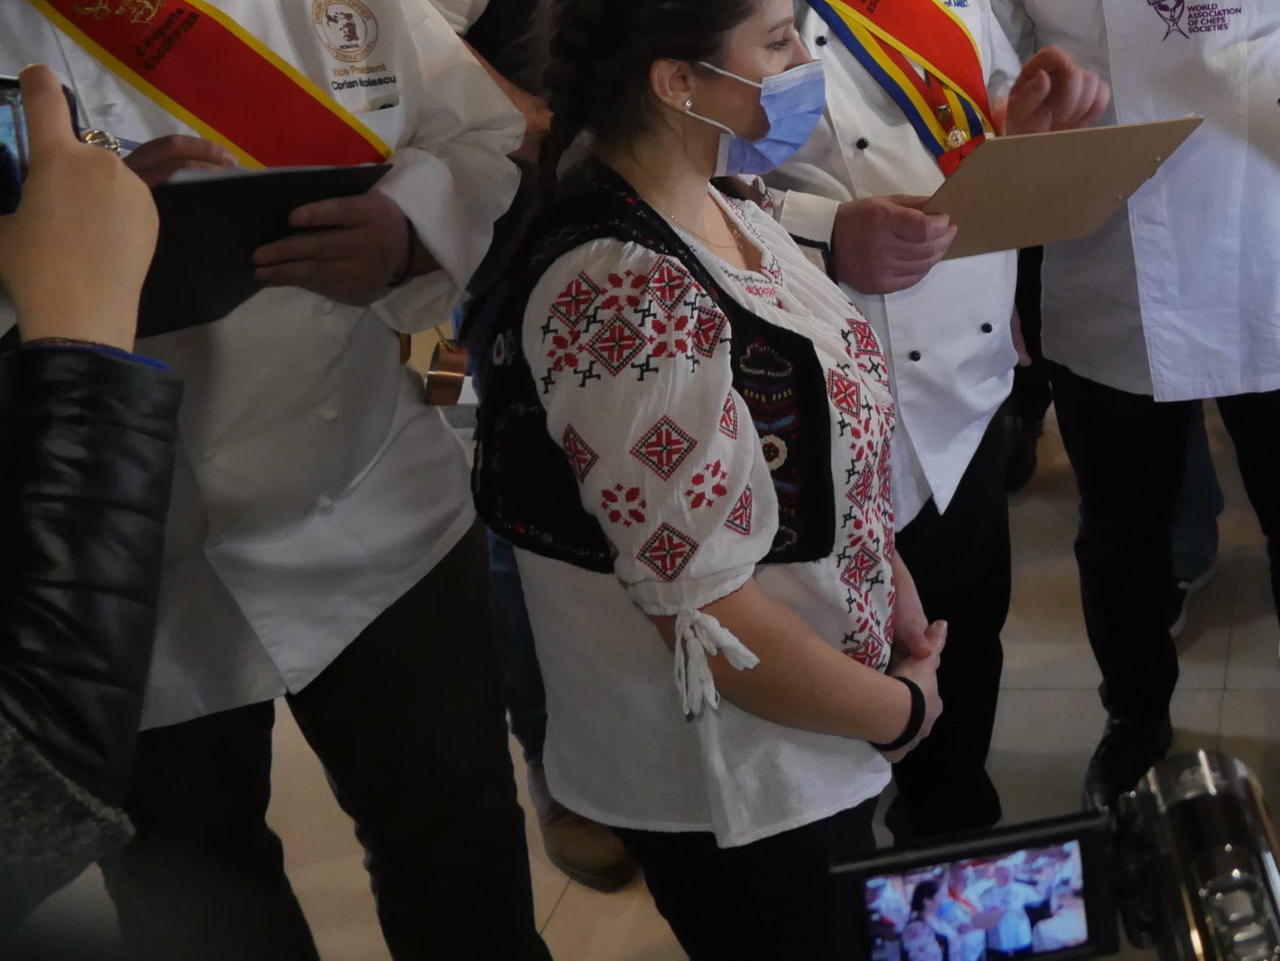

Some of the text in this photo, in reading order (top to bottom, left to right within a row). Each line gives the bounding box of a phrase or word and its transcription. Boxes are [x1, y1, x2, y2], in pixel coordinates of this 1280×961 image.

[1187, 3, 1218, 12] WORLD
[1188, 8, 1242, 19] ASSOCIATION
[1188, 17, 1226, 27] OF CHEFS
[1189, 23, 1229, 33] SOCIETIES
